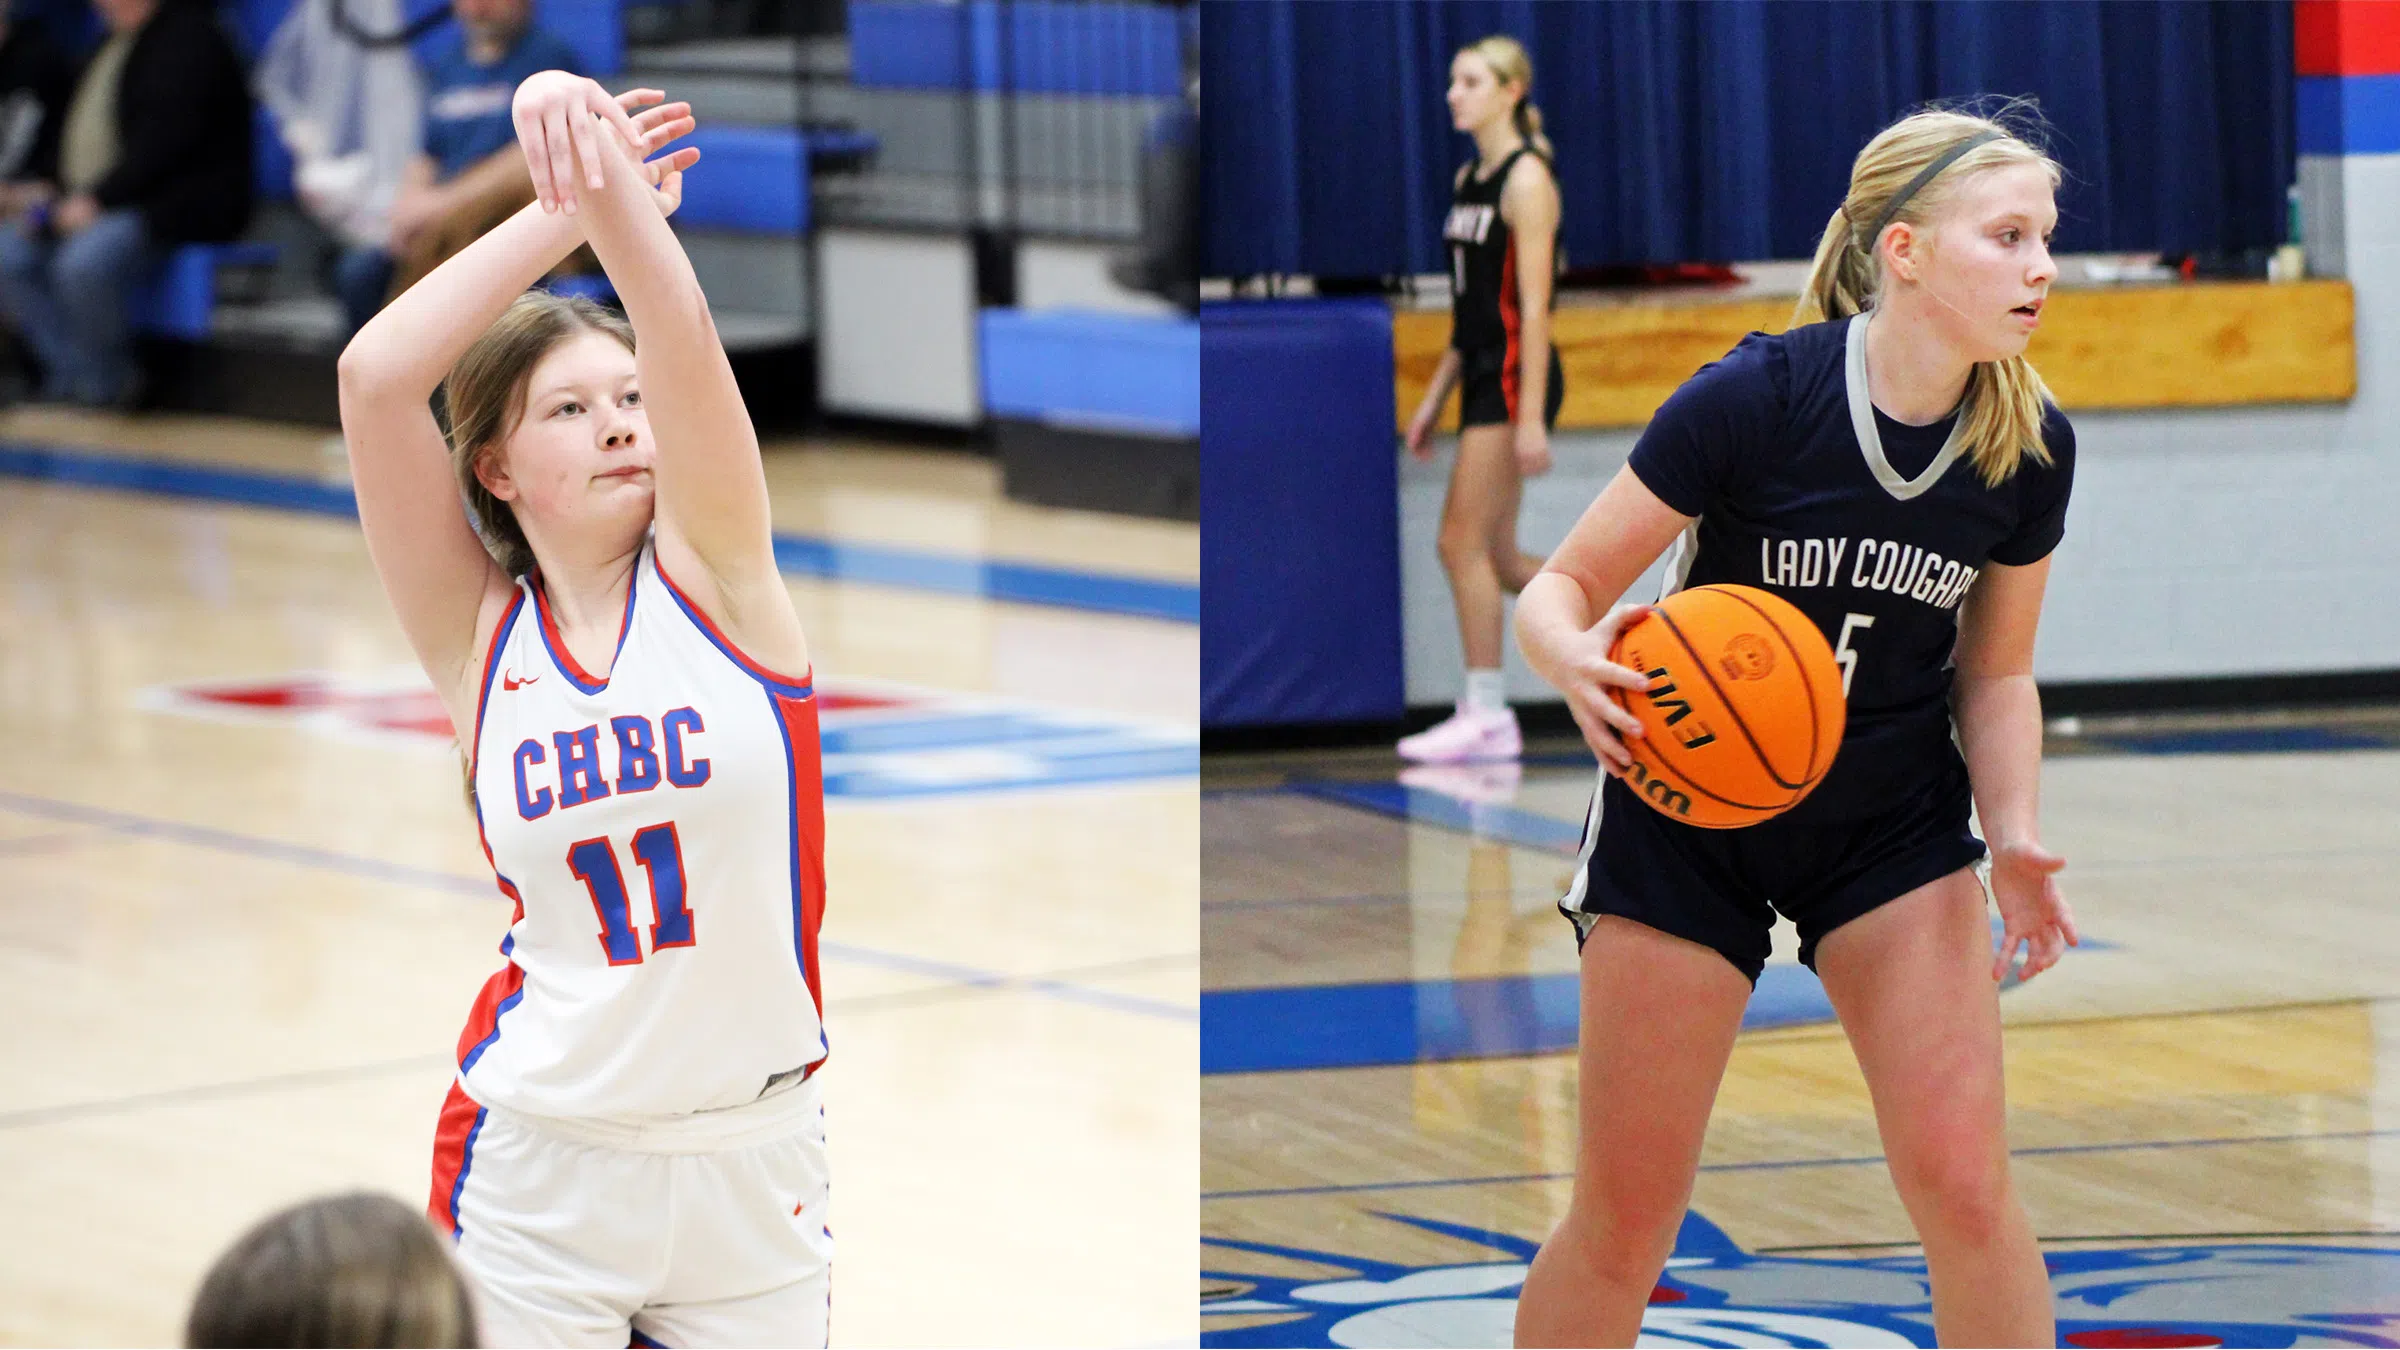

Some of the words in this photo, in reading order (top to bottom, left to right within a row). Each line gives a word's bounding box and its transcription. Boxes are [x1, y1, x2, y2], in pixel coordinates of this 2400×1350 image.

[1762, 537, 1847, 587] LADY
[1835, 612, 1875, 700] 5
[513, 706, 711, 821] CHBC
[566, 820, 696, 966] 11
